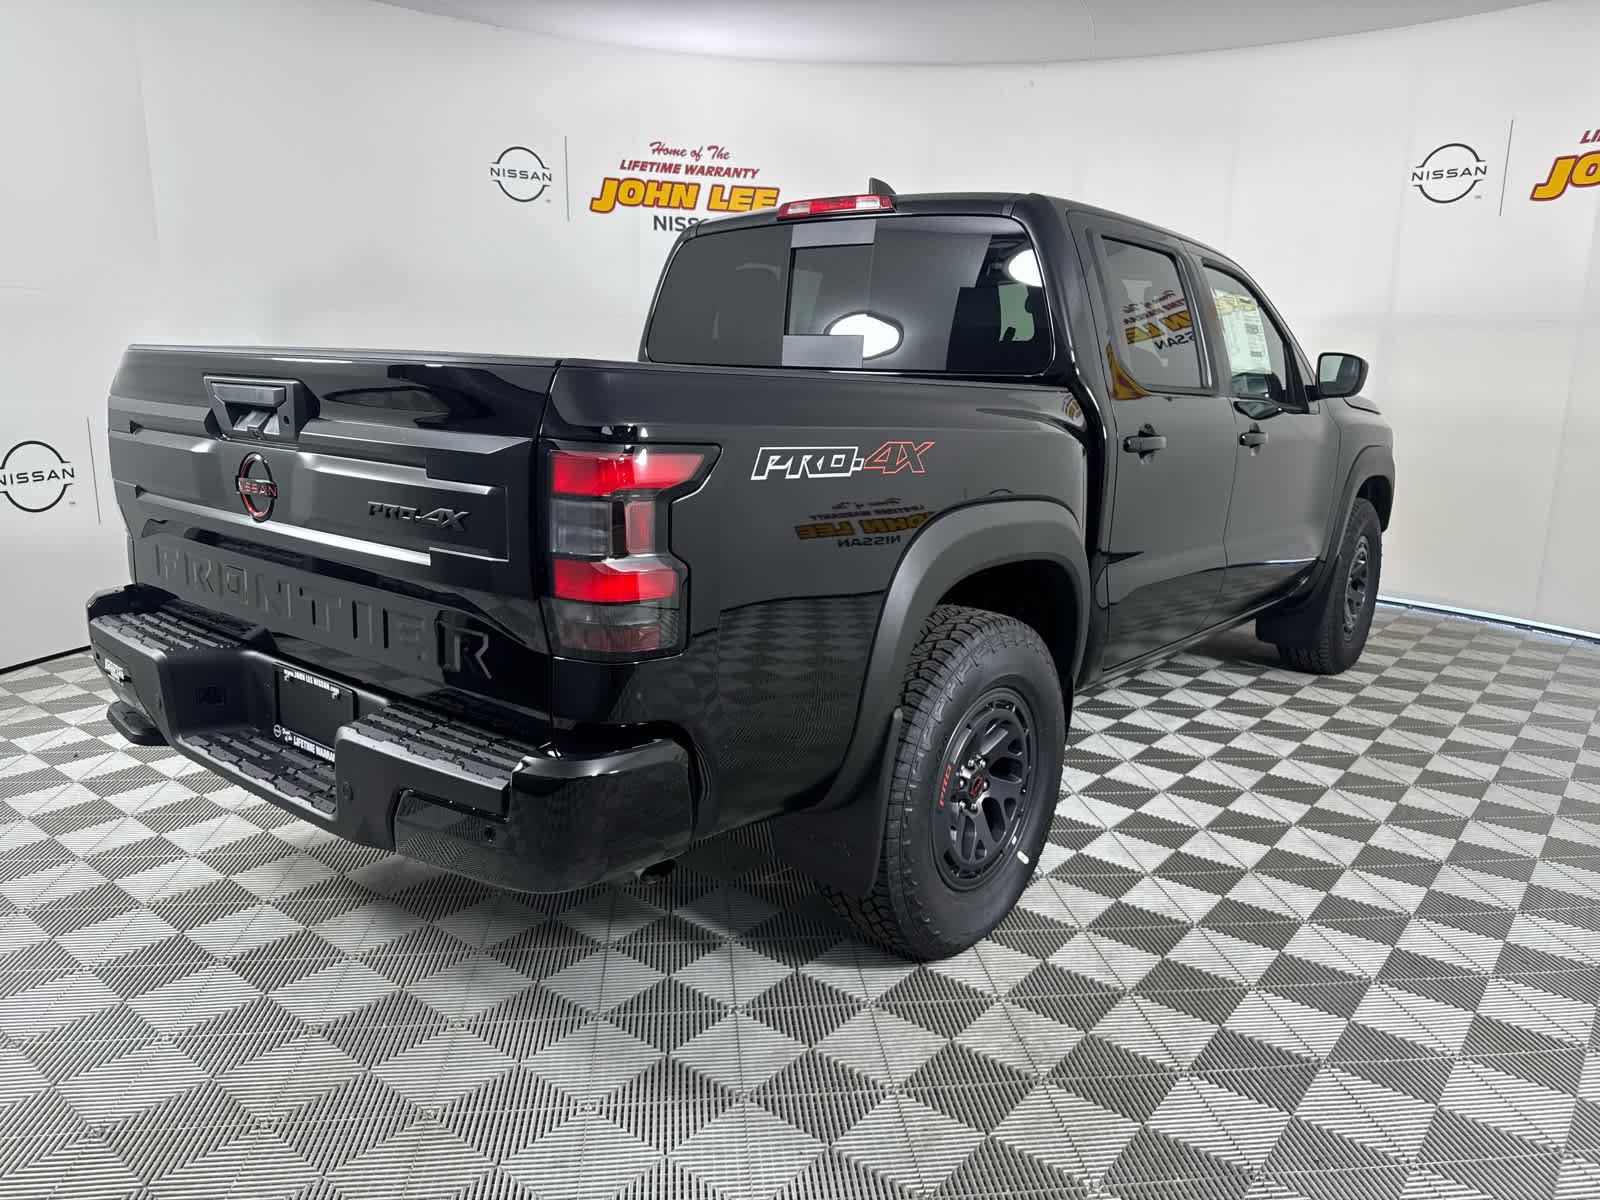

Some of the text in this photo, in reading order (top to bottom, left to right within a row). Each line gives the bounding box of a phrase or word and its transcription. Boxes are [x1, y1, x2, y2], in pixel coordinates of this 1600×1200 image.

[650, 141, 731, 161] Home of The
[490, 166, 552, 182] NISSAN
[619, 159, 760, 180] LIFETIME WARRANTY
[1411, 165, 1488, 182] NISSAN
[589, 177, 781, 214] JOHN LEE
[0, 467, 75, 486] NISSAN
[154, 544, 493, 681] FRONTIER
